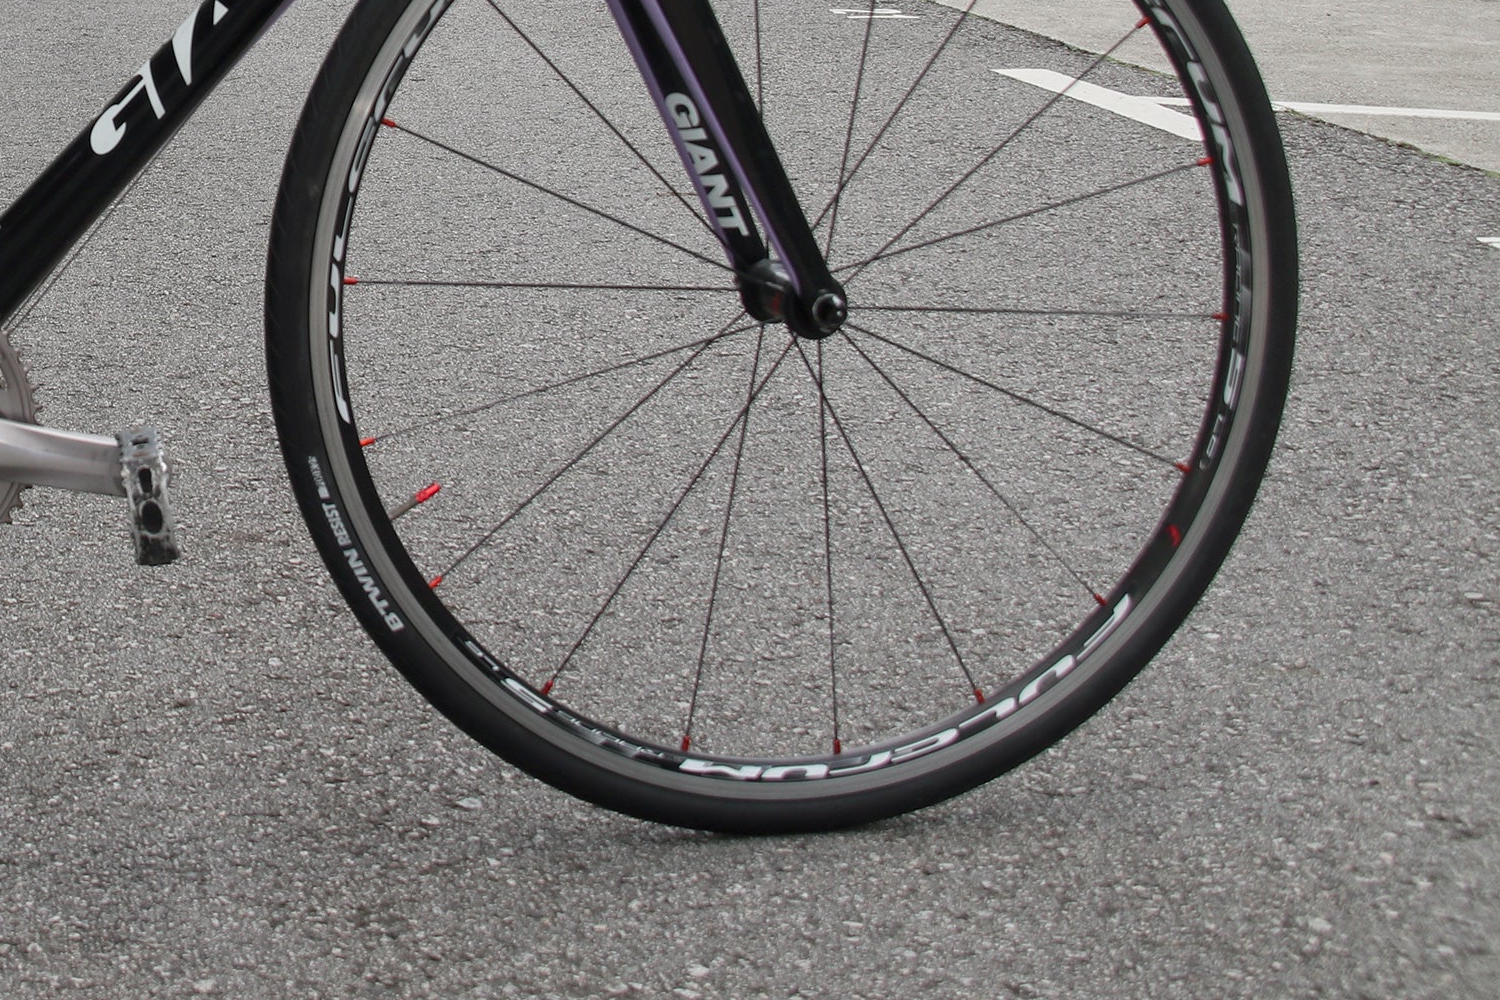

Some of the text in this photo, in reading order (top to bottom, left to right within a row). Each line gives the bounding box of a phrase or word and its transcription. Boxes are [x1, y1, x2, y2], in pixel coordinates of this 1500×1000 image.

[664, 92, 750, 236] GIANT
[322, 502, 351, 546] RESIST
[677, 592, 1136, 778] FULCRUM
